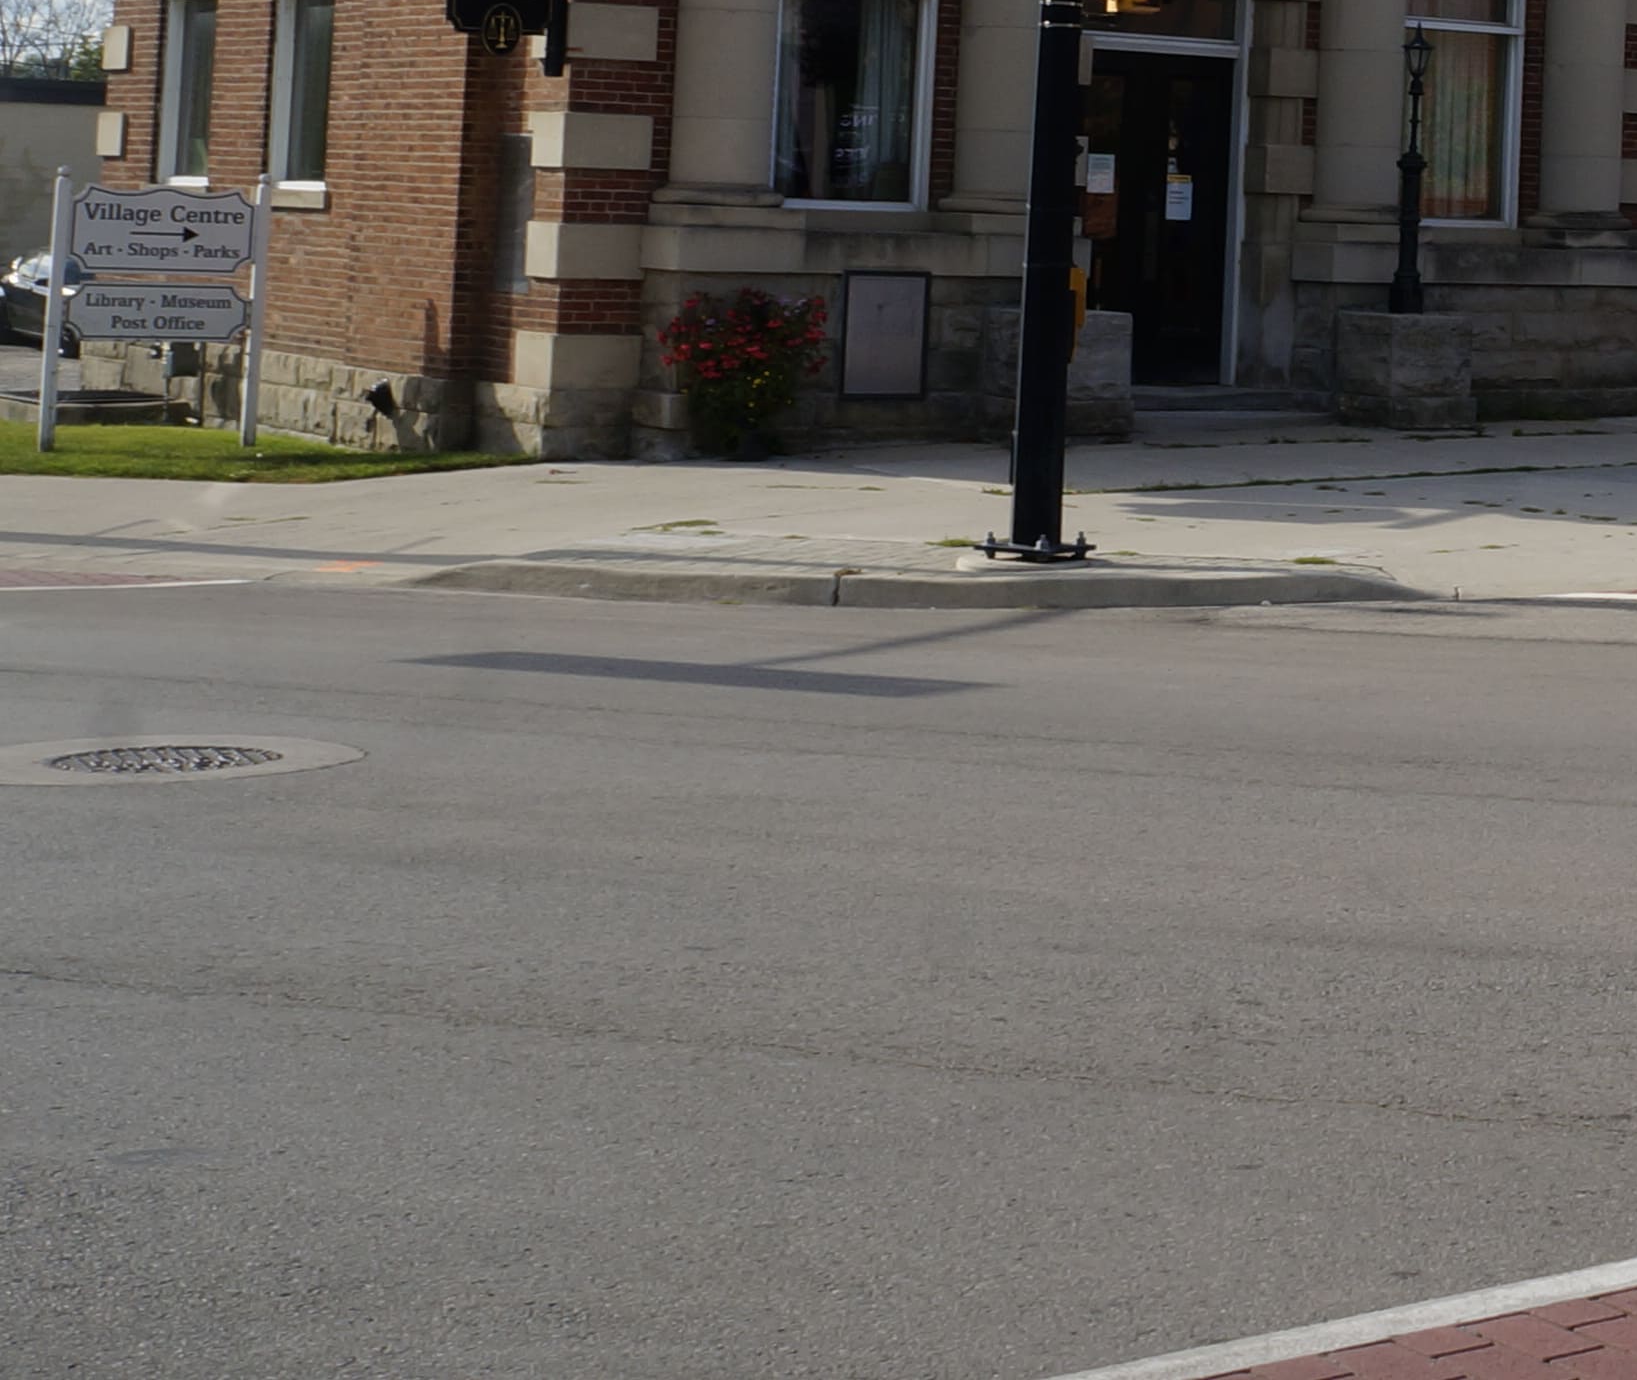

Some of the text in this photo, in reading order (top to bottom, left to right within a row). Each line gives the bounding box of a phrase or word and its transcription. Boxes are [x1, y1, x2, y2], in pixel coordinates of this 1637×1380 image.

[84, 202, 245, 226] Village Centre
[84, 242, 113, 256] Art
[127, 242, 178, 260] Shops
[193, 244, 241, 259] Parks
[85, 293, 145, 311] Library
[160, 294, 232, 309] Museum
[111, 315, 206, 331] Post Office
